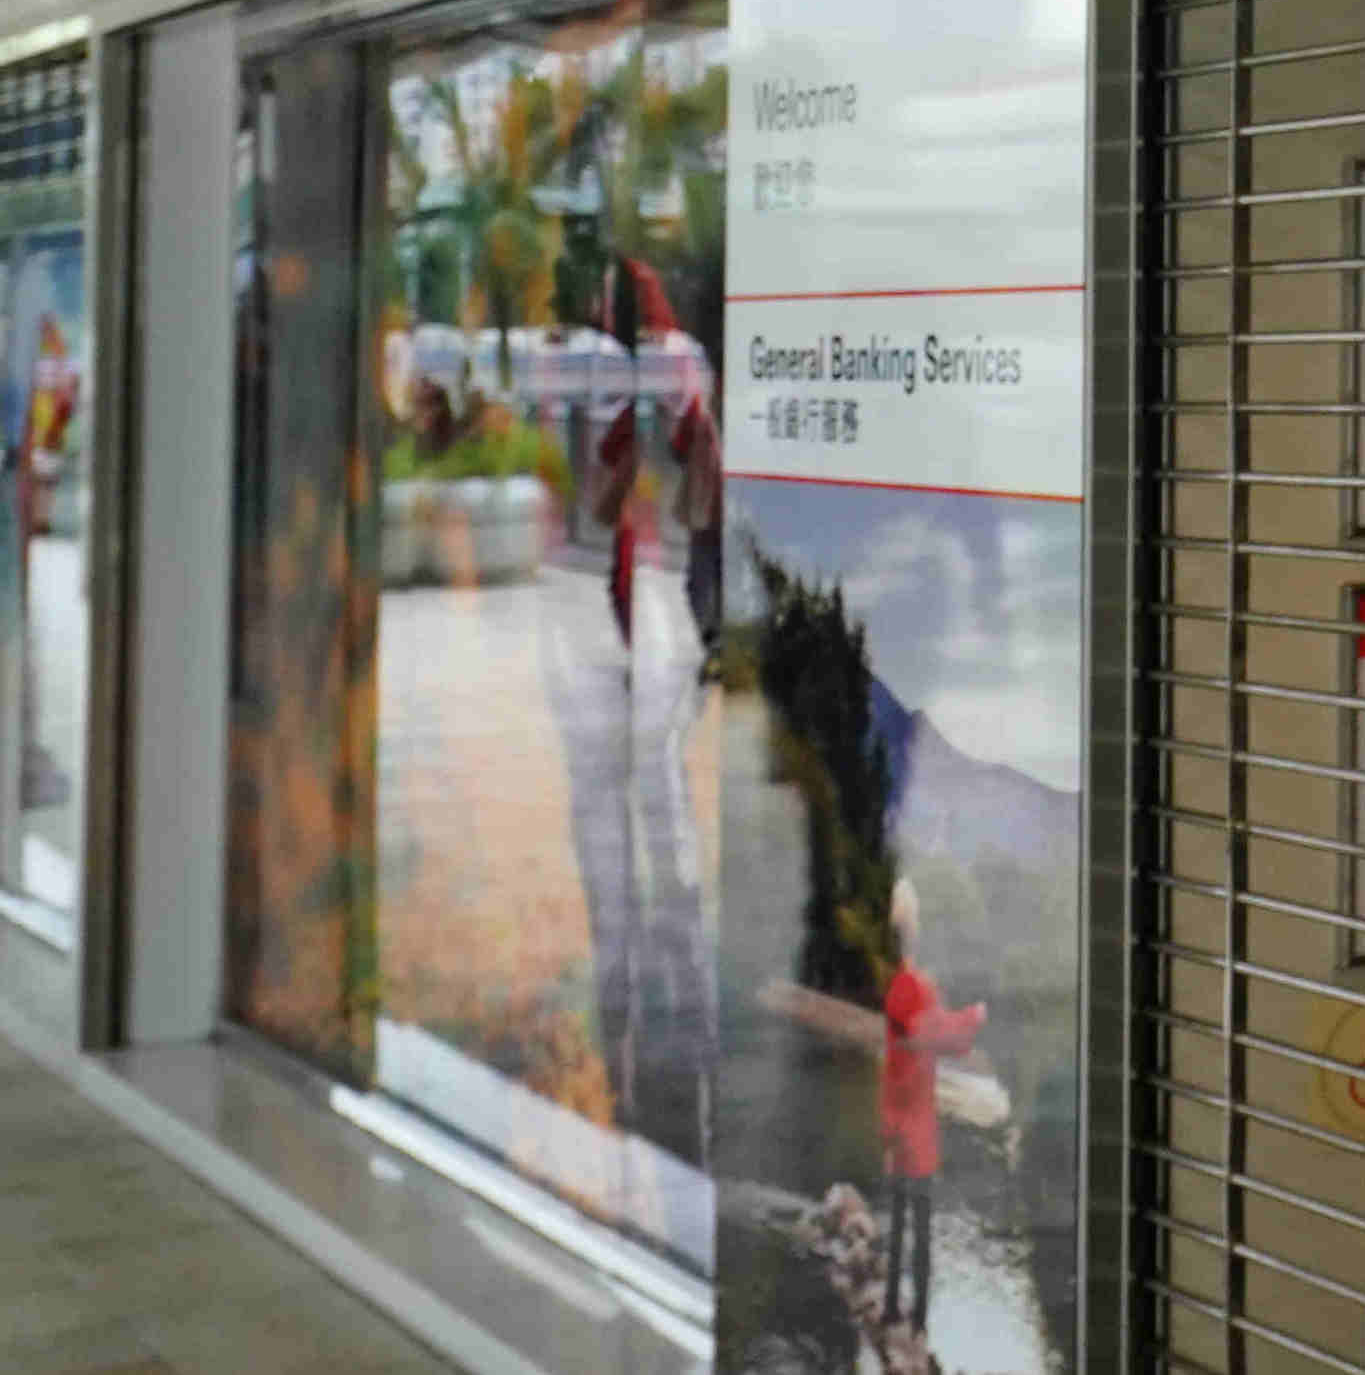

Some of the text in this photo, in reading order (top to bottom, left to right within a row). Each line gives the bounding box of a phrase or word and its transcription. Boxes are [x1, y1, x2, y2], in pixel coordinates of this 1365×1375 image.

[752, 77, 857, 133] Welcome
[750, 333, 1021, 394] General Banking Services
